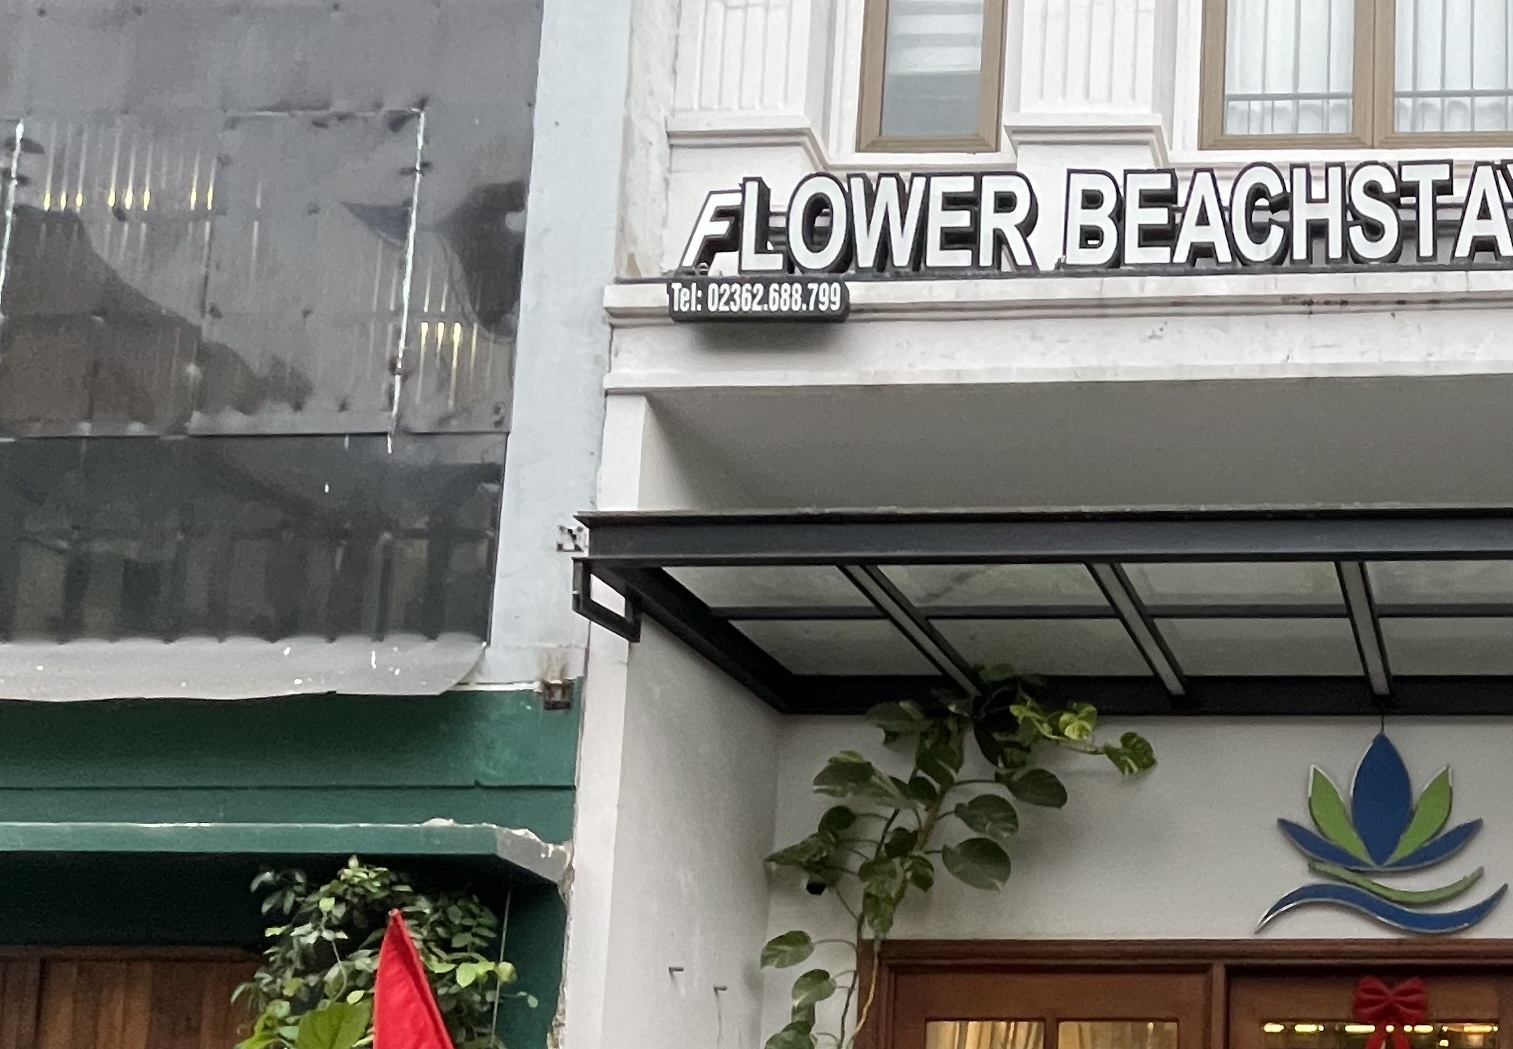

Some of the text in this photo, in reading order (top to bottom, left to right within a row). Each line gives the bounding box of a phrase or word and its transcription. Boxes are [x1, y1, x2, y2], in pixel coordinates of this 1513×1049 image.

[680, 171, 1038, 274] FLOWER
[671, 282, 842, 312] Tel: 02362.688.799
